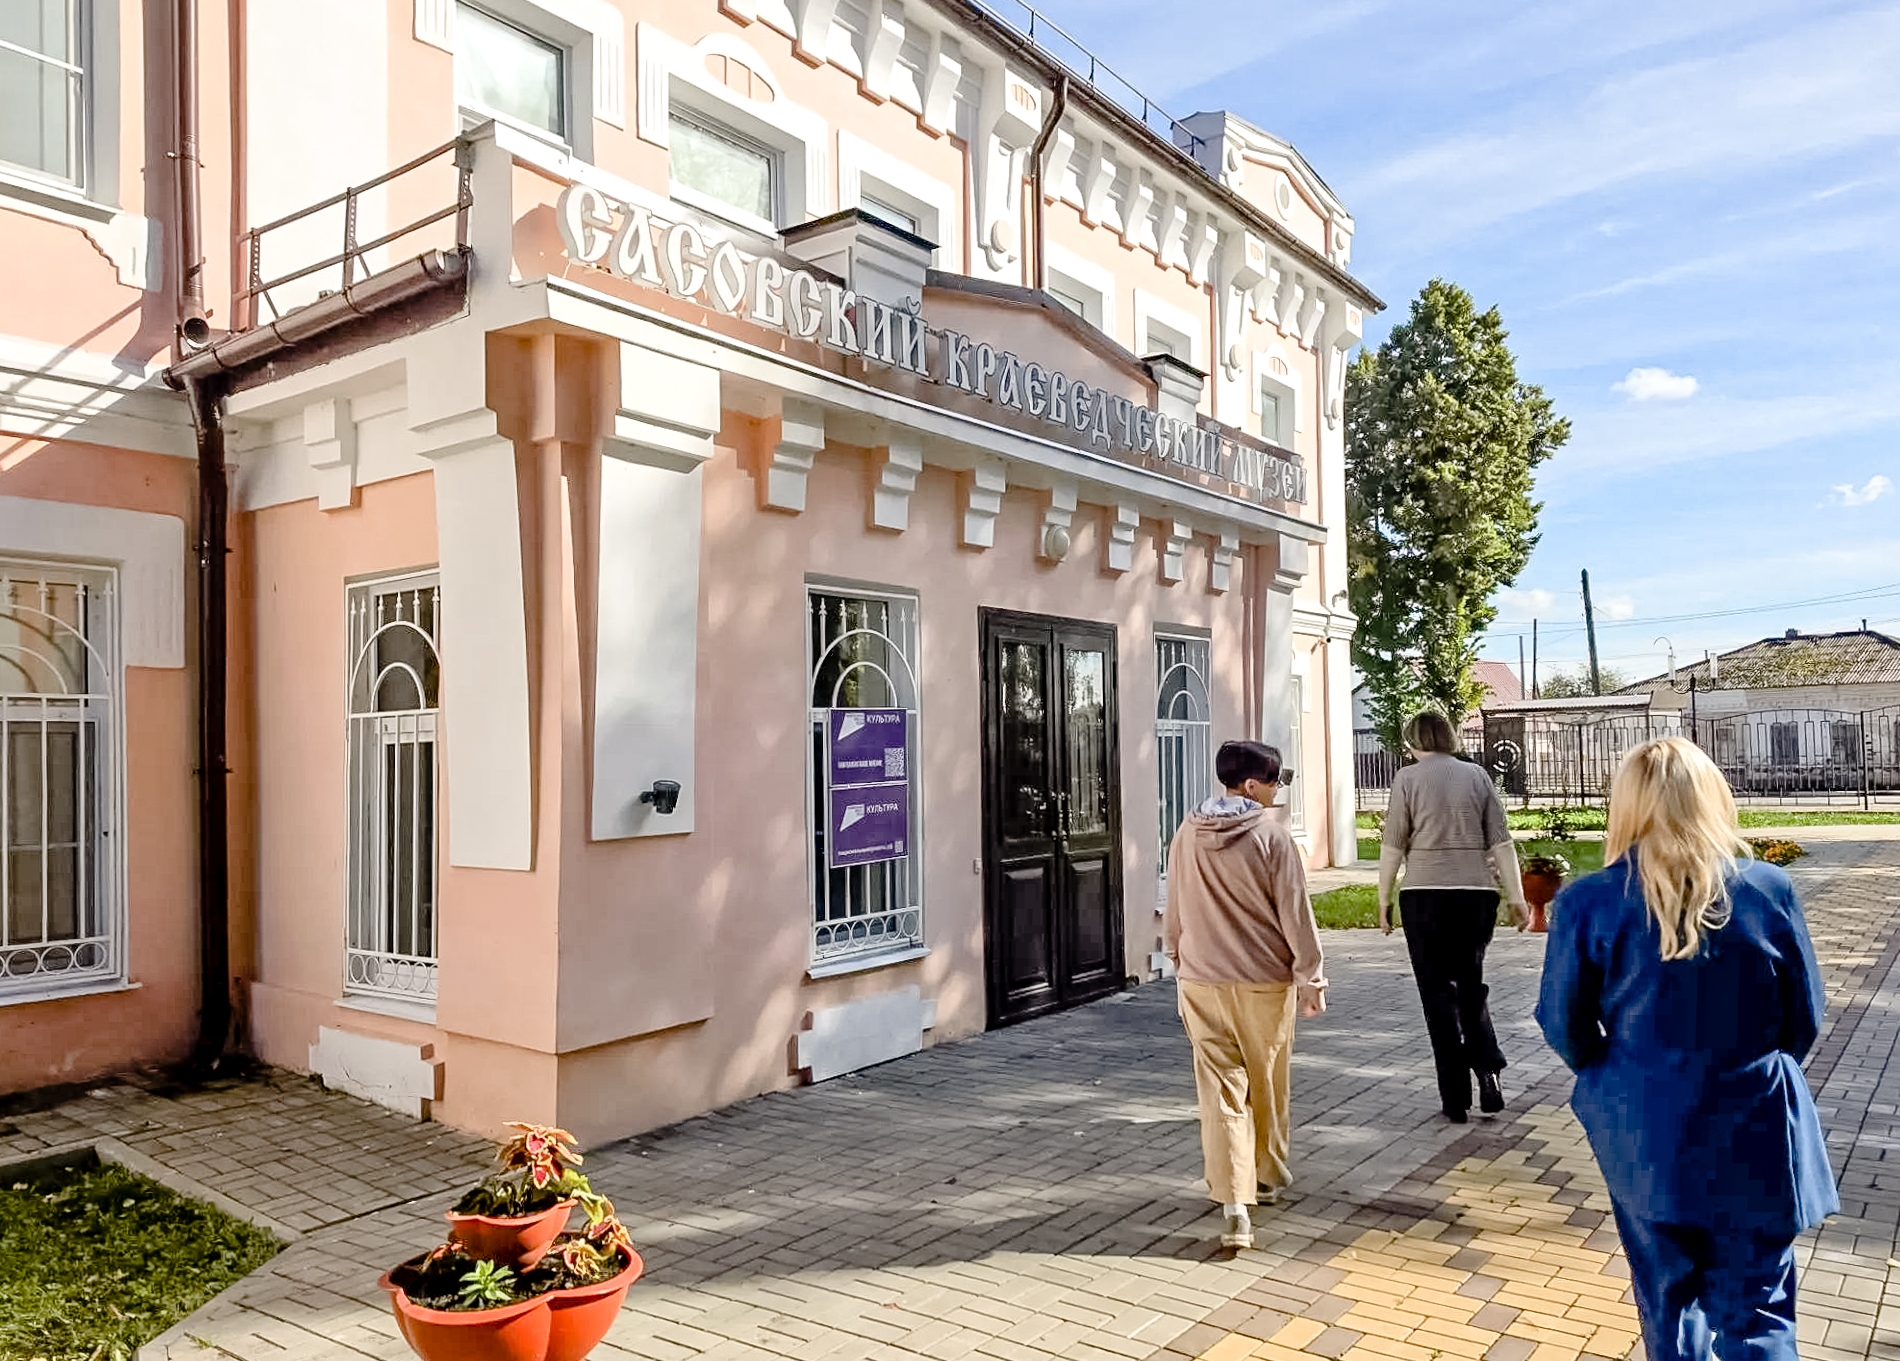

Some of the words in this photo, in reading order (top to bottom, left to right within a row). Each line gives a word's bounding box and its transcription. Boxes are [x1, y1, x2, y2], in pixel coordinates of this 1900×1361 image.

[558, 183, 930, 377] САСОВСКИЙ
[945, 328, 1225, 477] КРАЕВЕДЧЕСКИЙ
[1232, 443, 1307, 505] МУЗЕЙ
[866, 714, 900, 724] КУЛЬТУРА
[866, 802, 898, 814] КУЛЬТУРА
